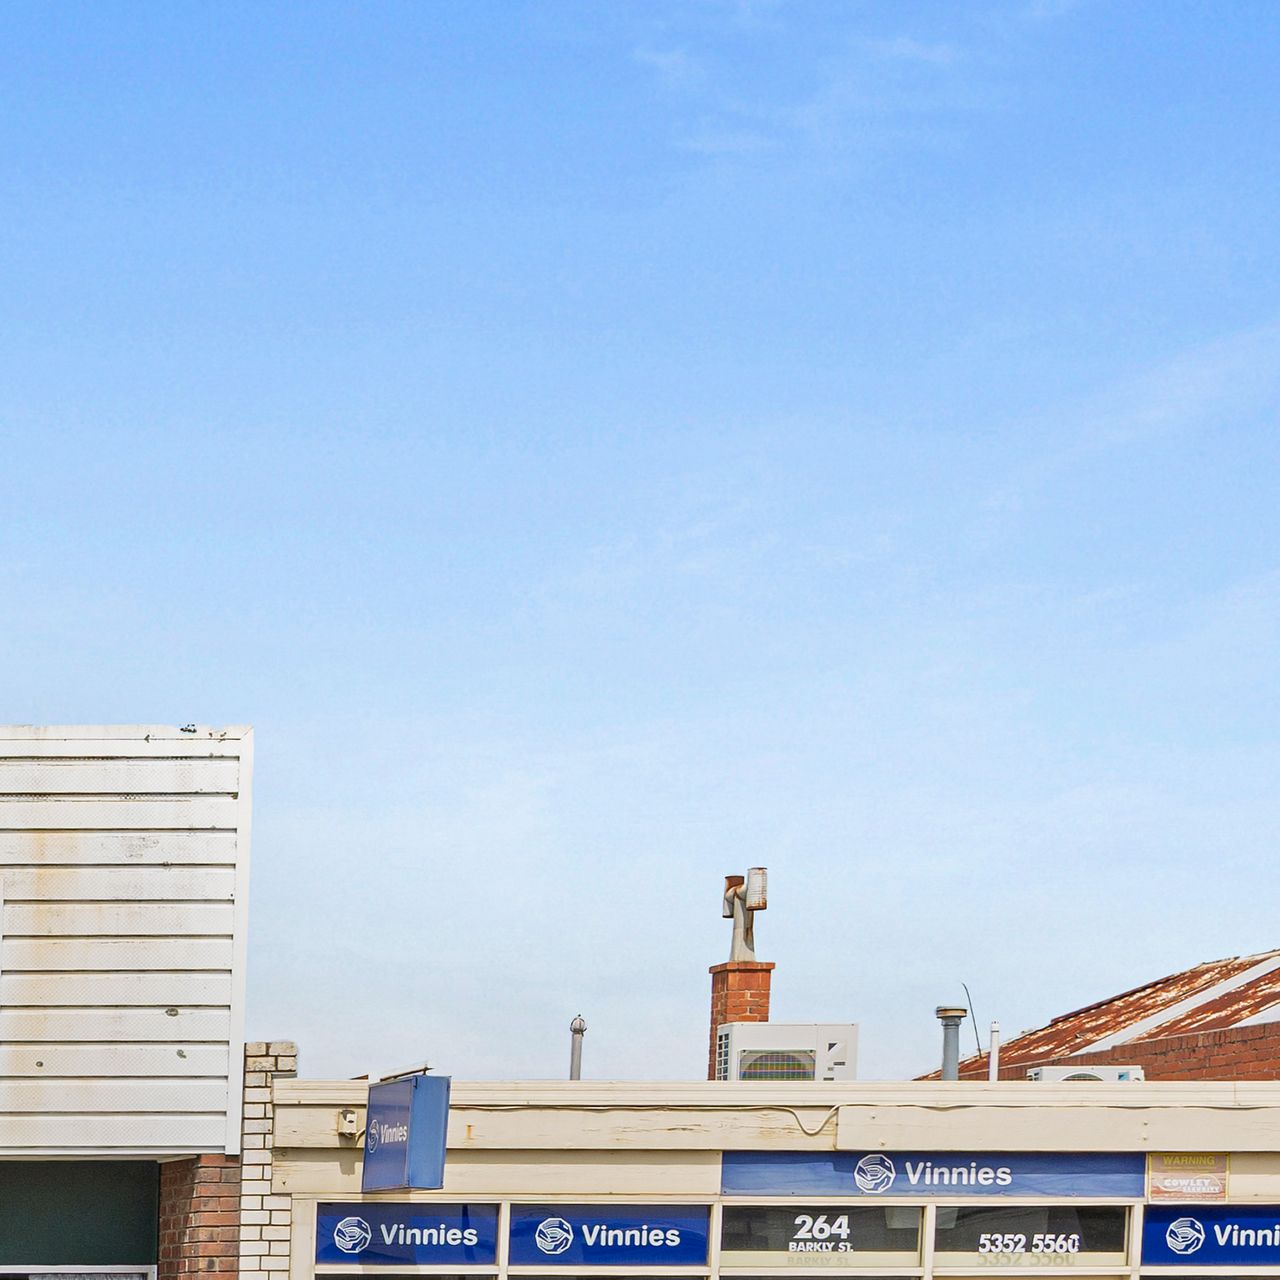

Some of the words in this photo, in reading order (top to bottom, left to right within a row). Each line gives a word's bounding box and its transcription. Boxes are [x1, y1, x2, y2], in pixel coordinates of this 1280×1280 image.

[380, 1122, 408, 1144] Vinnies
[1162, 1155, 1216, 1166] WARNING
[905, 1161, 1013, 1186] Vinnies
[1164, 1178, 1211, 1187] COWLEY
[380, 1223, 479, 1246] Vinnies
[581, 1224, 681, 1247] Vinnies
[793, 1214, 851, 1240] 264
[788, 1241, 836, 1252] BARKLY
[978, 1233, 1027, 1253] 5352
[1031, 1233, 1081, 1253] 5560
